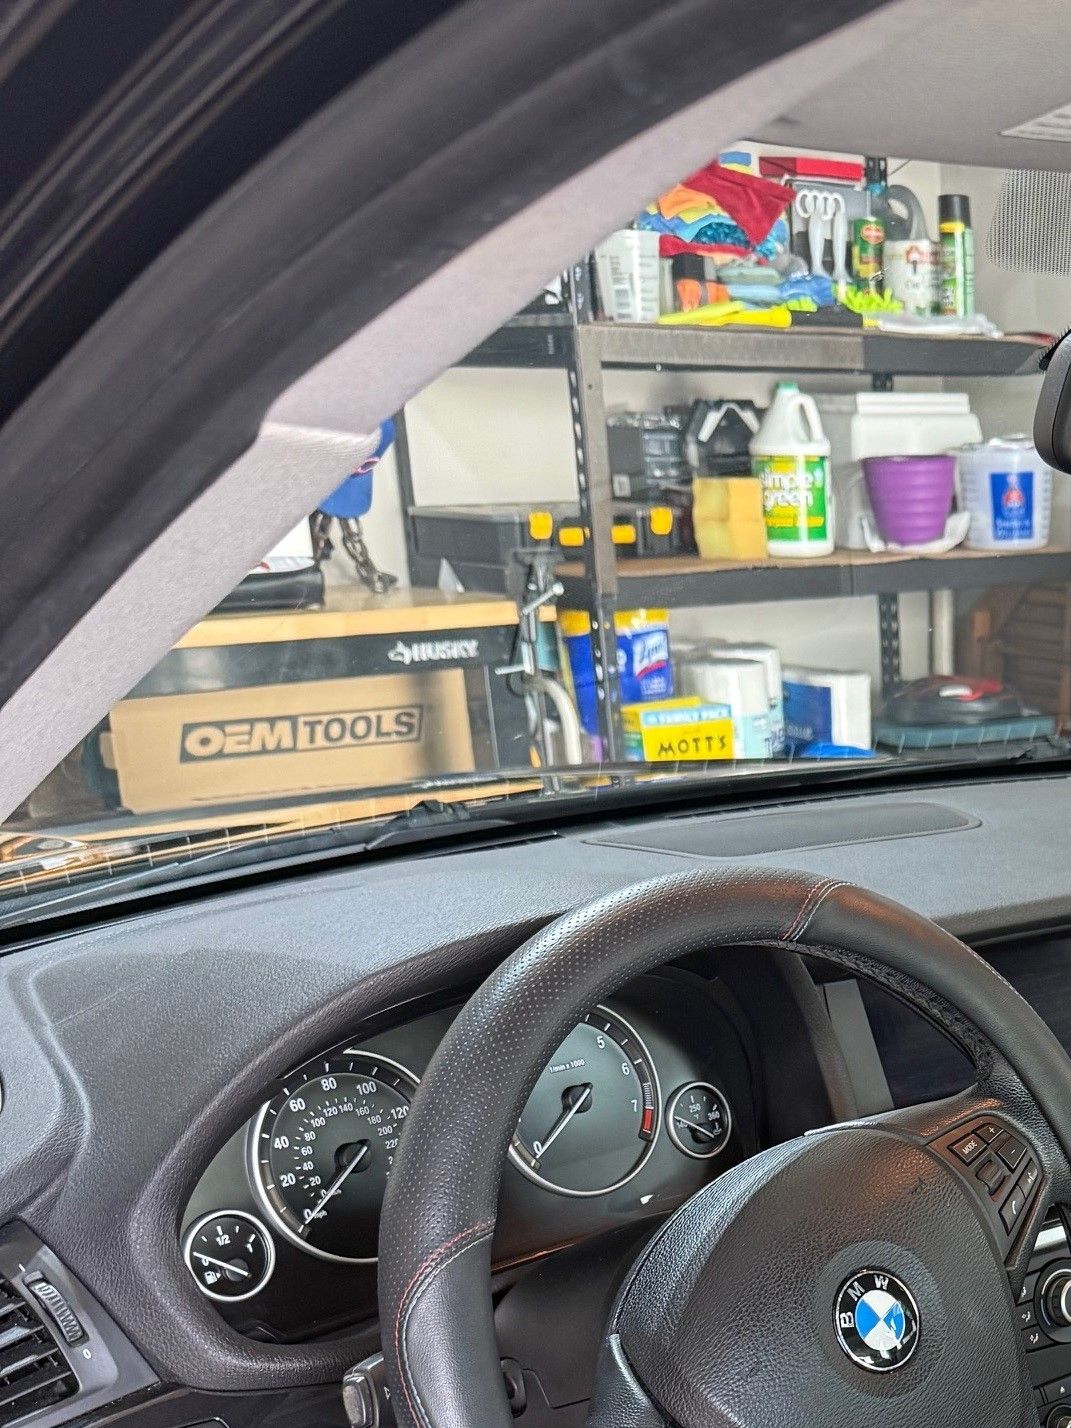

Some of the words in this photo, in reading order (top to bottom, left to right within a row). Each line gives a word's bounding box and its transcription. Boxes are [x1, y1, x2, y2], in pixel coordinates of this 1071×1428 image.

[410, 640, 479, 662] HUSKY
[183, 718, 294, 758] OEM
[303, 711, 418, 745] TOOLS
[596, 1035, 606, 1049] 5
[621, 1062, 631, 1076] 6
[320, 1077, 338, 1092] 80
[356, 1081, 378, 1096] 100
[289, 1098, 306, 1113] 60
[323, 1106, 338, 1118] 120
[338, 1102, 354, 1113] 140
[355, 1106, 370, 1117] 160
[631, 1099, 638, 1112] 7
[310, 1116, 326, 1128] 100
[367, 1115, 382, 1126] 180
[304, 1131, 316, 1142] 80
[377, 1125, 393, 1137] 200
[273, 1136, 290, 1150] 40
[962, 1139, 978, 1156] MODE
[301, 1146, 313, 1157] 60
[302, 1160, 314, 1171] 40
[280, 1172, 297, 1188] 20
[309, 1175, 321, 1186] 20
[216, 1234, 231, 1247] 1/2
[839, 1274, 890, 1328] BMW
